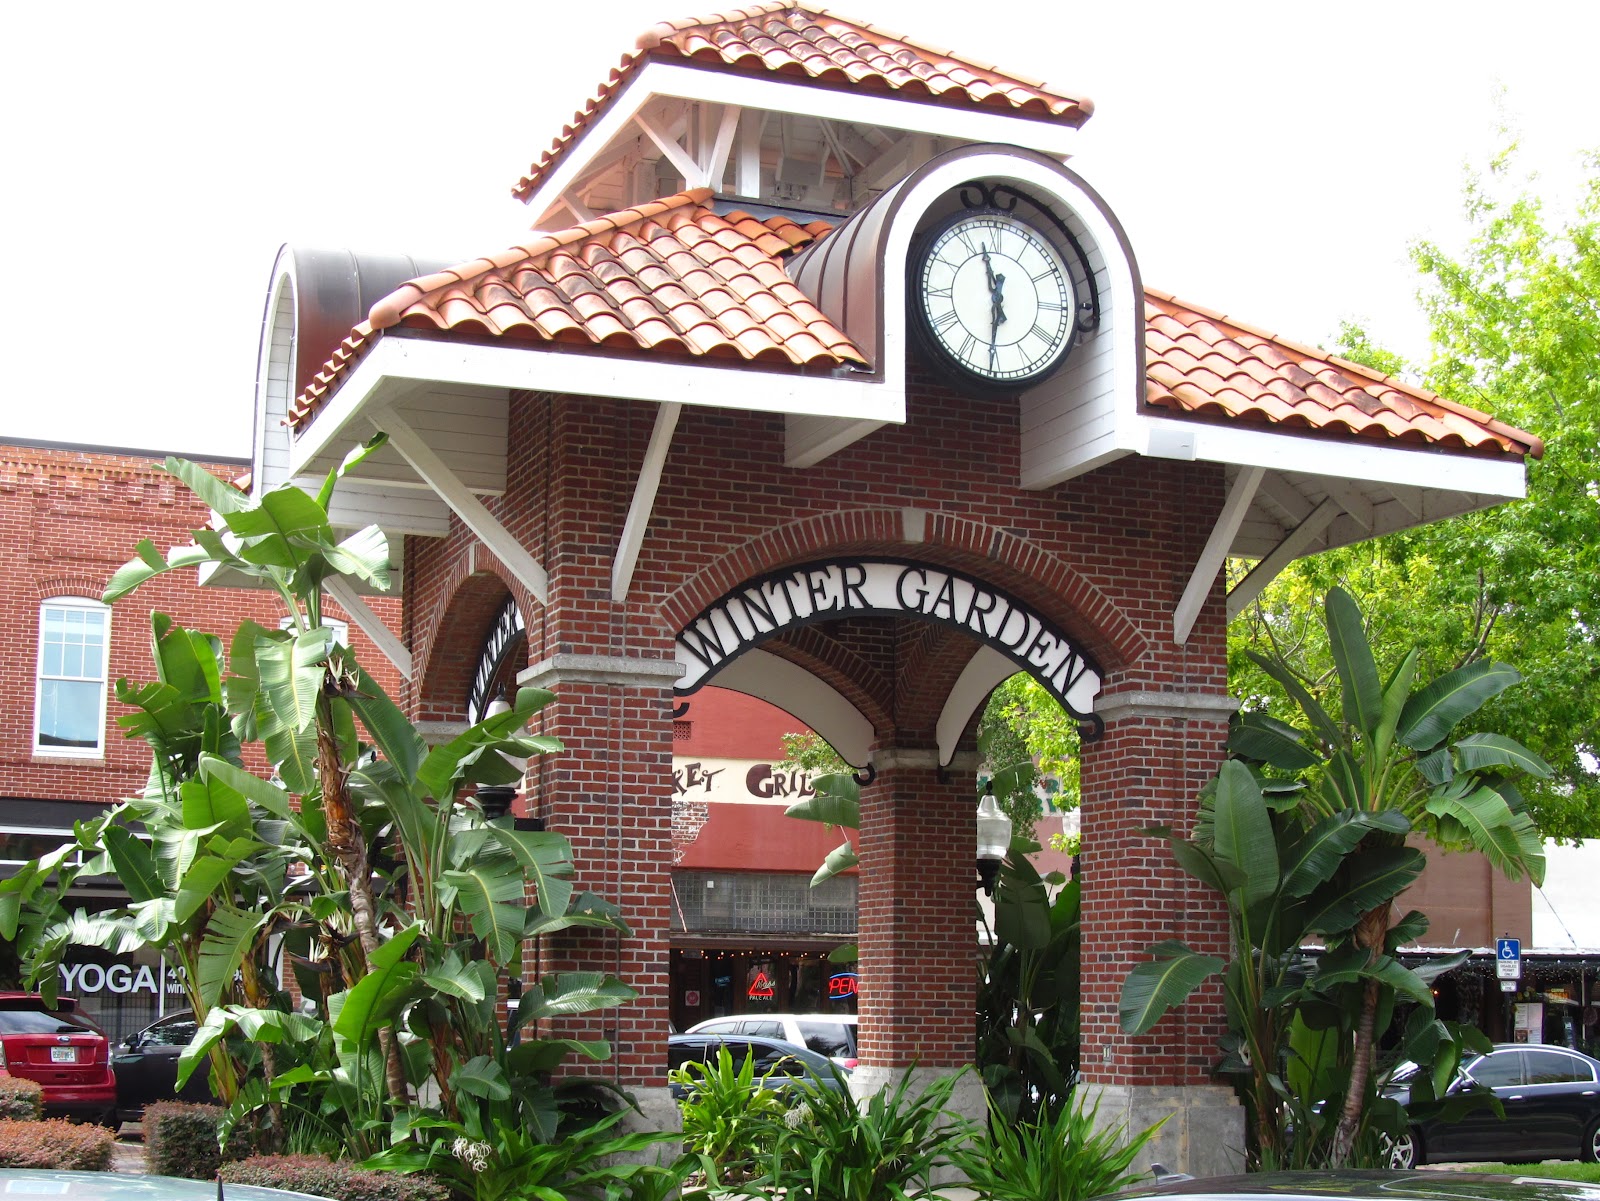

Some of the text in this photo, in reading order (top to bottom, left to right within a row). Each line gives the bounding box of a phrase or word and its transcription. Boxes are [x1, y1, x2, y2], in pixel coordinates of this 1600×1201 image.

[677, 563, 1094, 698] WINTER GARDEN
[671, 762, 829, 799] KET GRIL
[59, 963, 158, 993] YOGA
[755, 979, 775, 989] Bass
[829, 977, 858, 994] PEN
